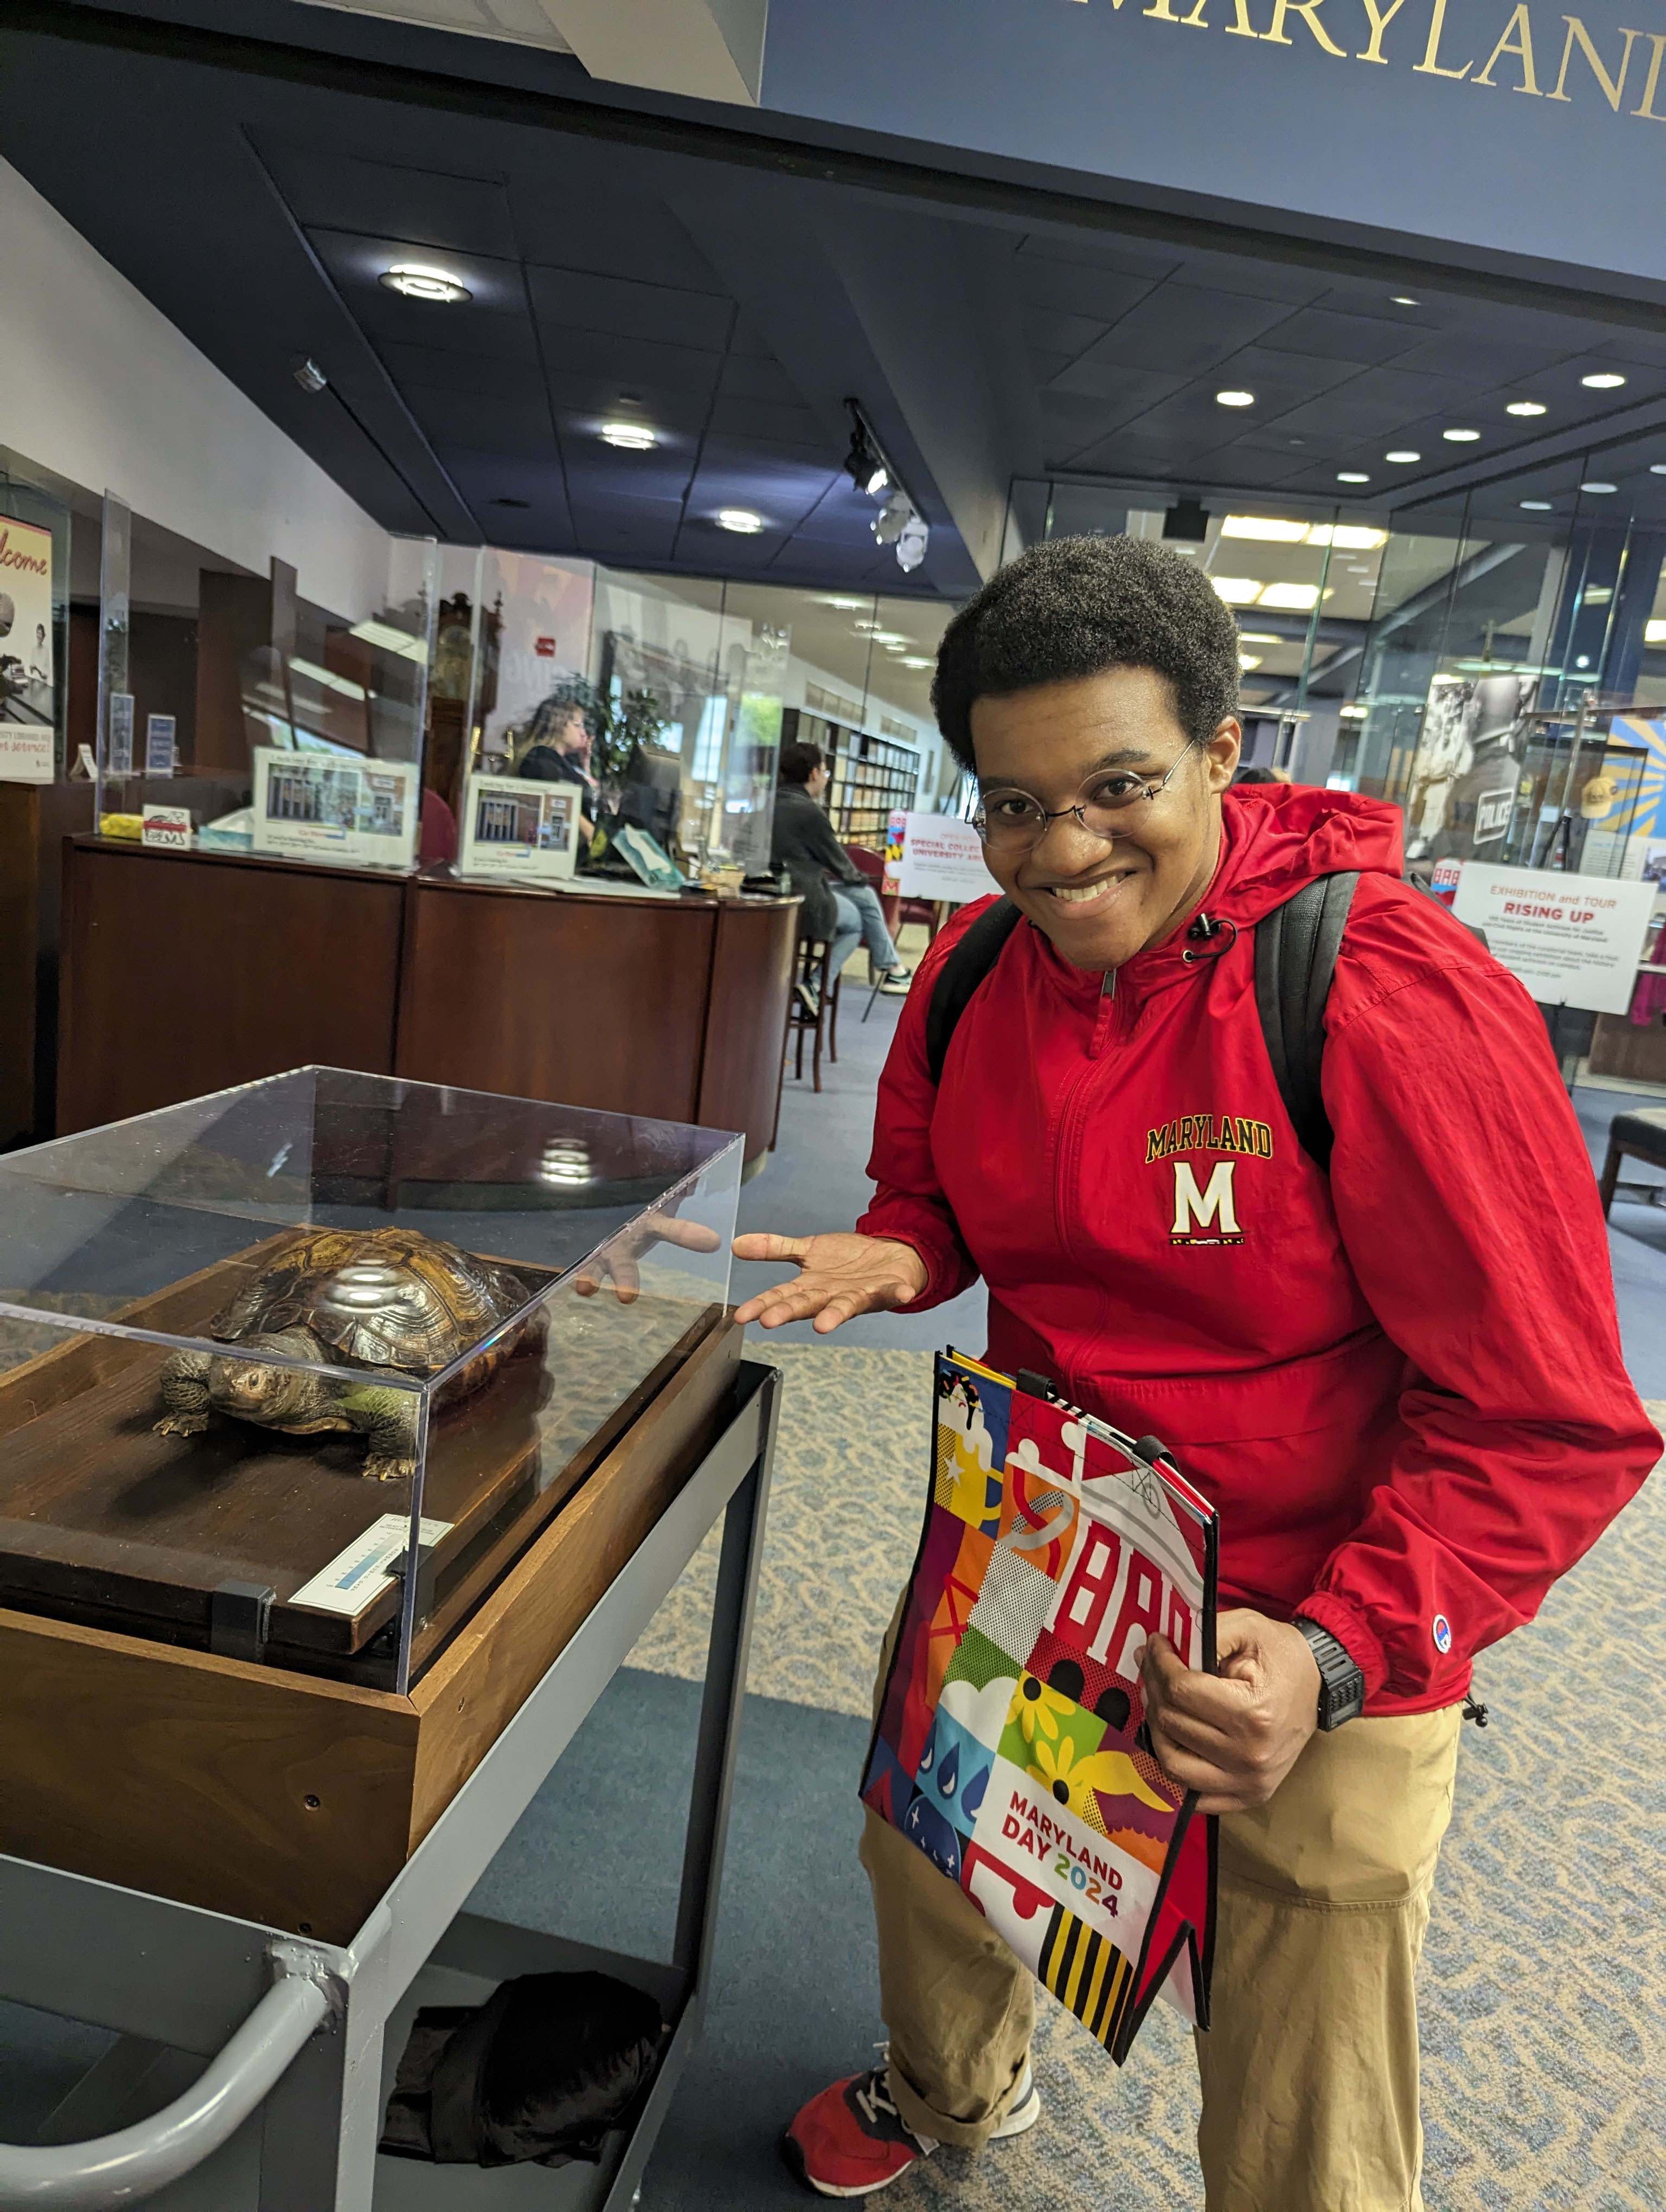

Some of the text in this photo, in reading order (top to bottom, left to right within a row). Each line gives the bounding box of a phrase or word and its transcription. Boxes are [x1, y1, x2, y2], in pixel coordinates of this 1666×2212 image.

[1478, 801, 1511, 832] POLICE
[911, 839, 945, 849] SPECIAL
[913, 848, 964, 859] UNIVERSITY
[1490, 884, 1618, 909] EXHIBITION and TOUR
[1503, 902, 1594, 924] RISING UP
[1145, 1114, 1273, 1163] MARYLAND
[1169, 1160, 1244, 1234] M
[1009, 1790, 1123, 1891] MARYLAND
[1001, 1814, 1118, 1918] DAY 2024
